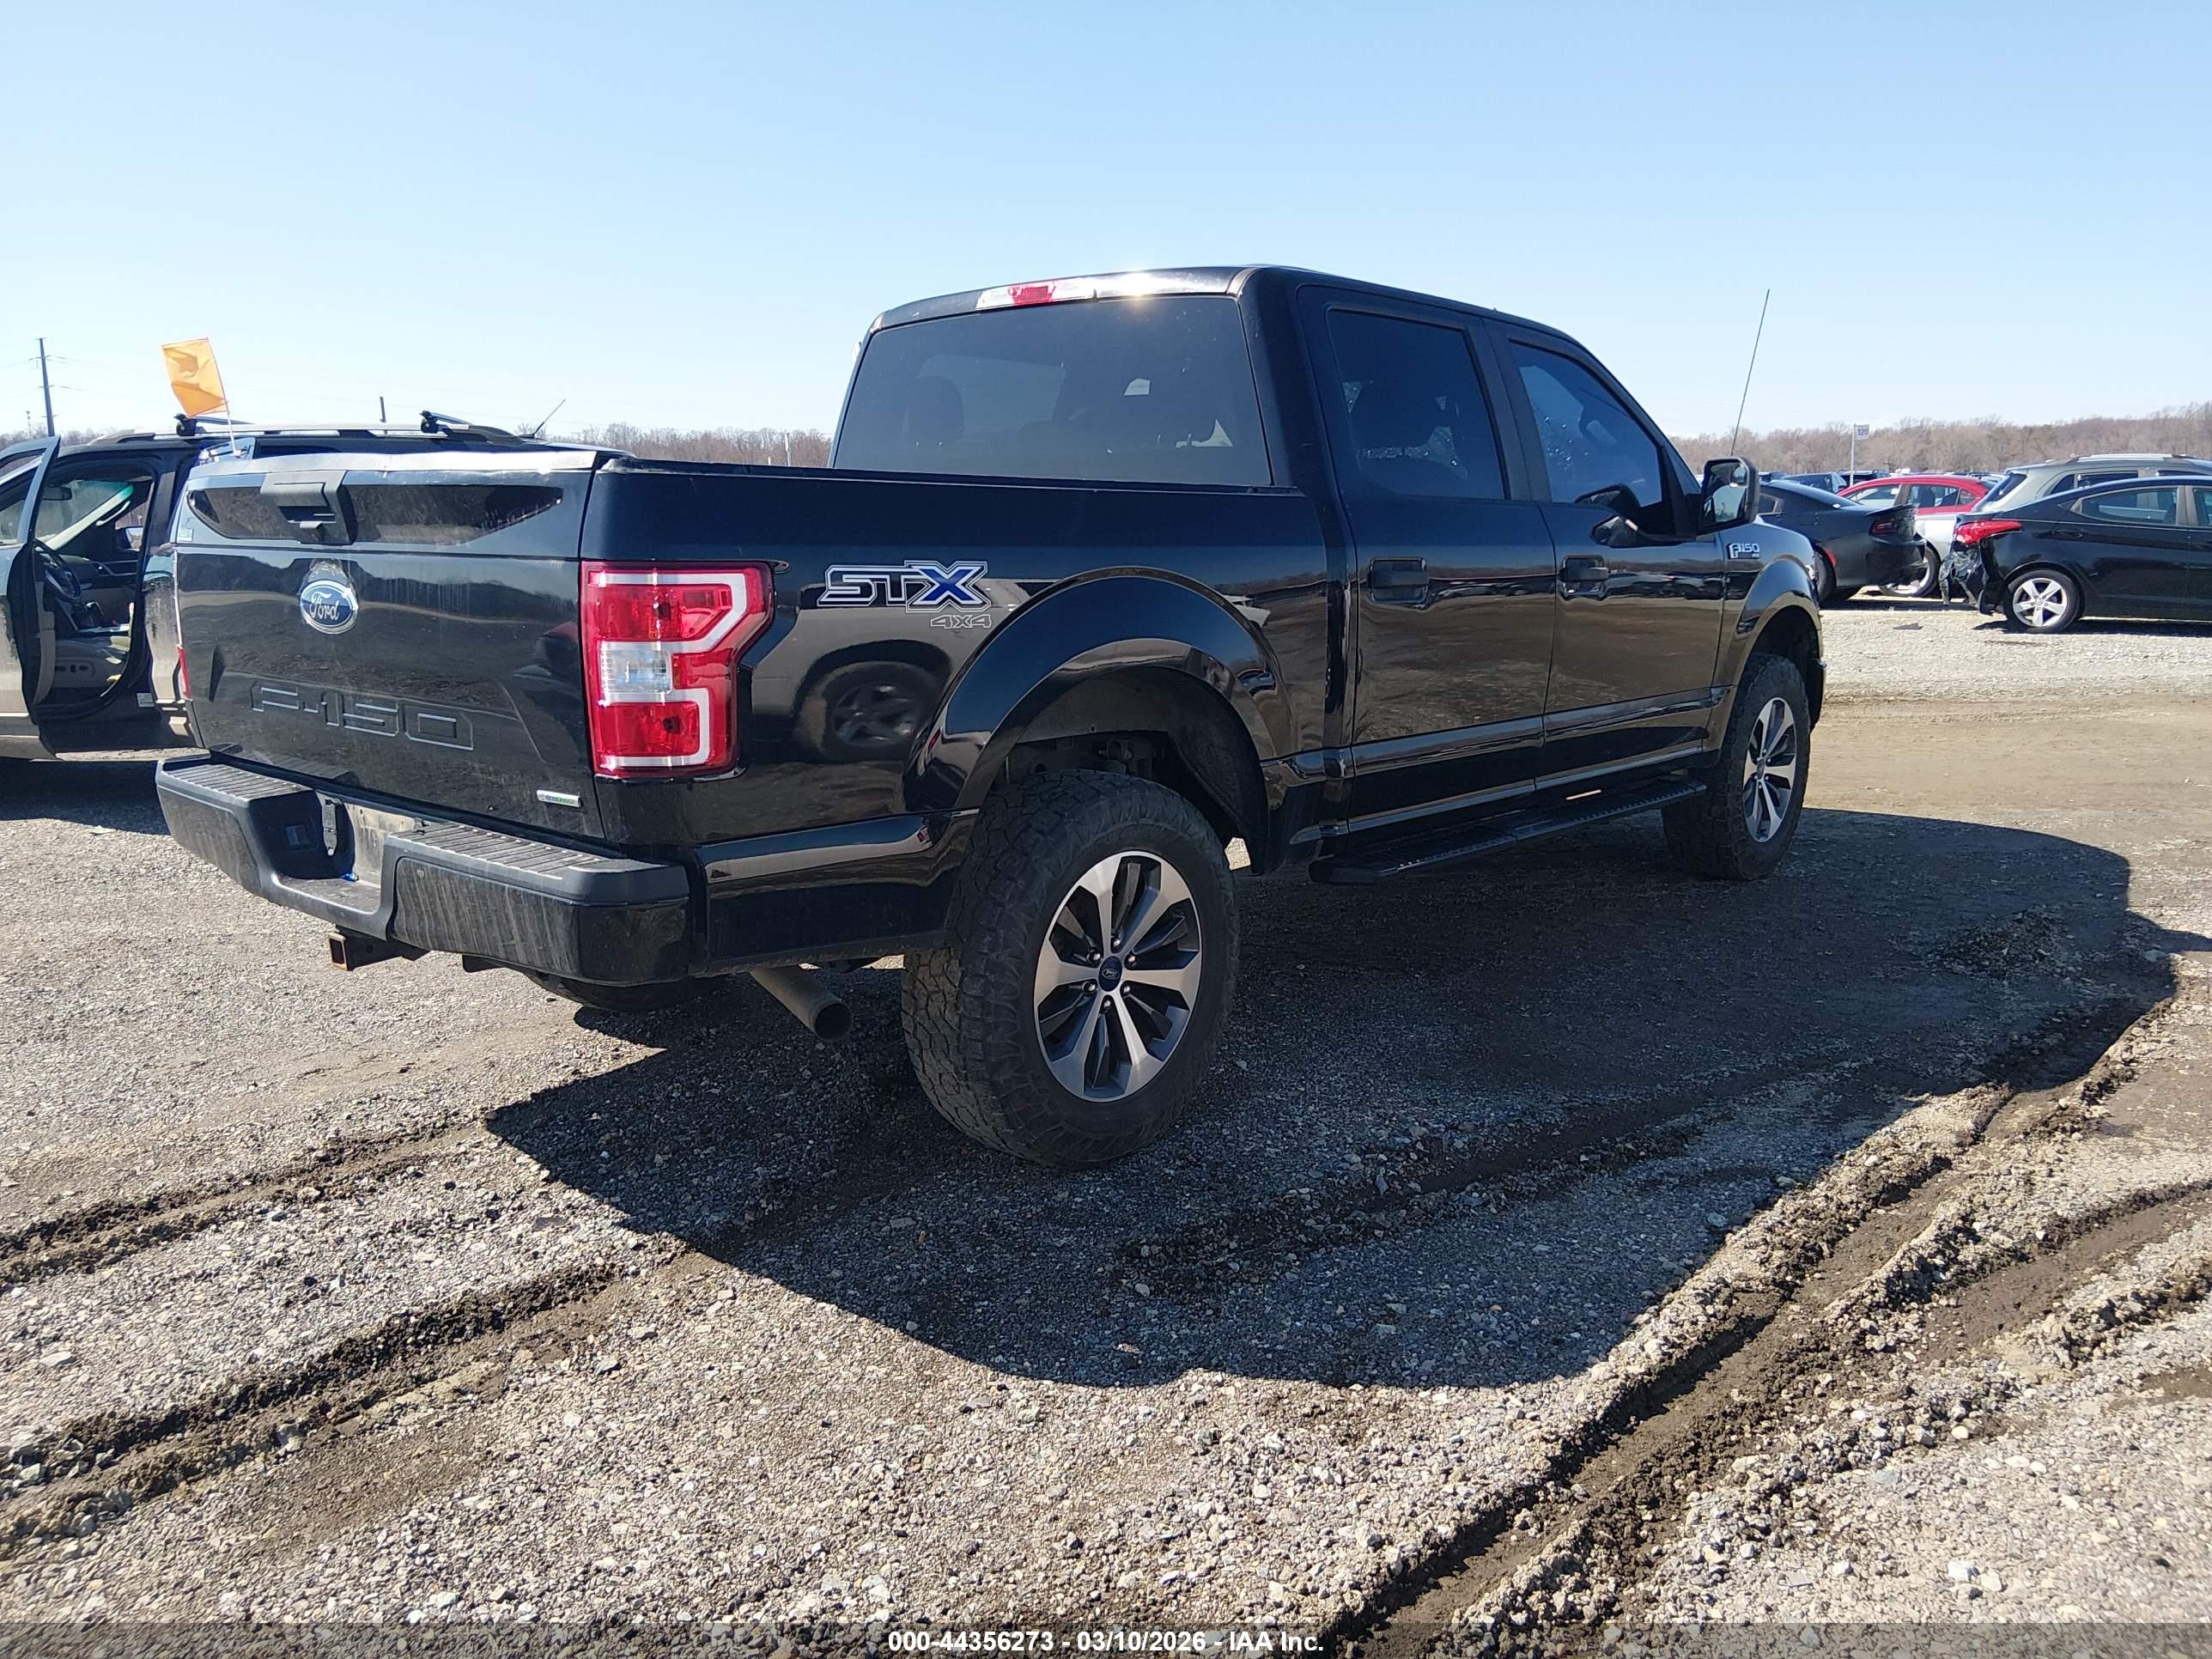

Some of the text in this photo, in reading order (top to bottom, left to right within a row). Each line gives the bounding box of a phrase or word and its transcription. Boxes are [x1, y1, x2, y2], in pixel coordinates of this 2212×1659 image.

[309, 591, 340, 621] Ford
[817, 560, 992, 613] STX
[250, 680, 474, 751] F-150
